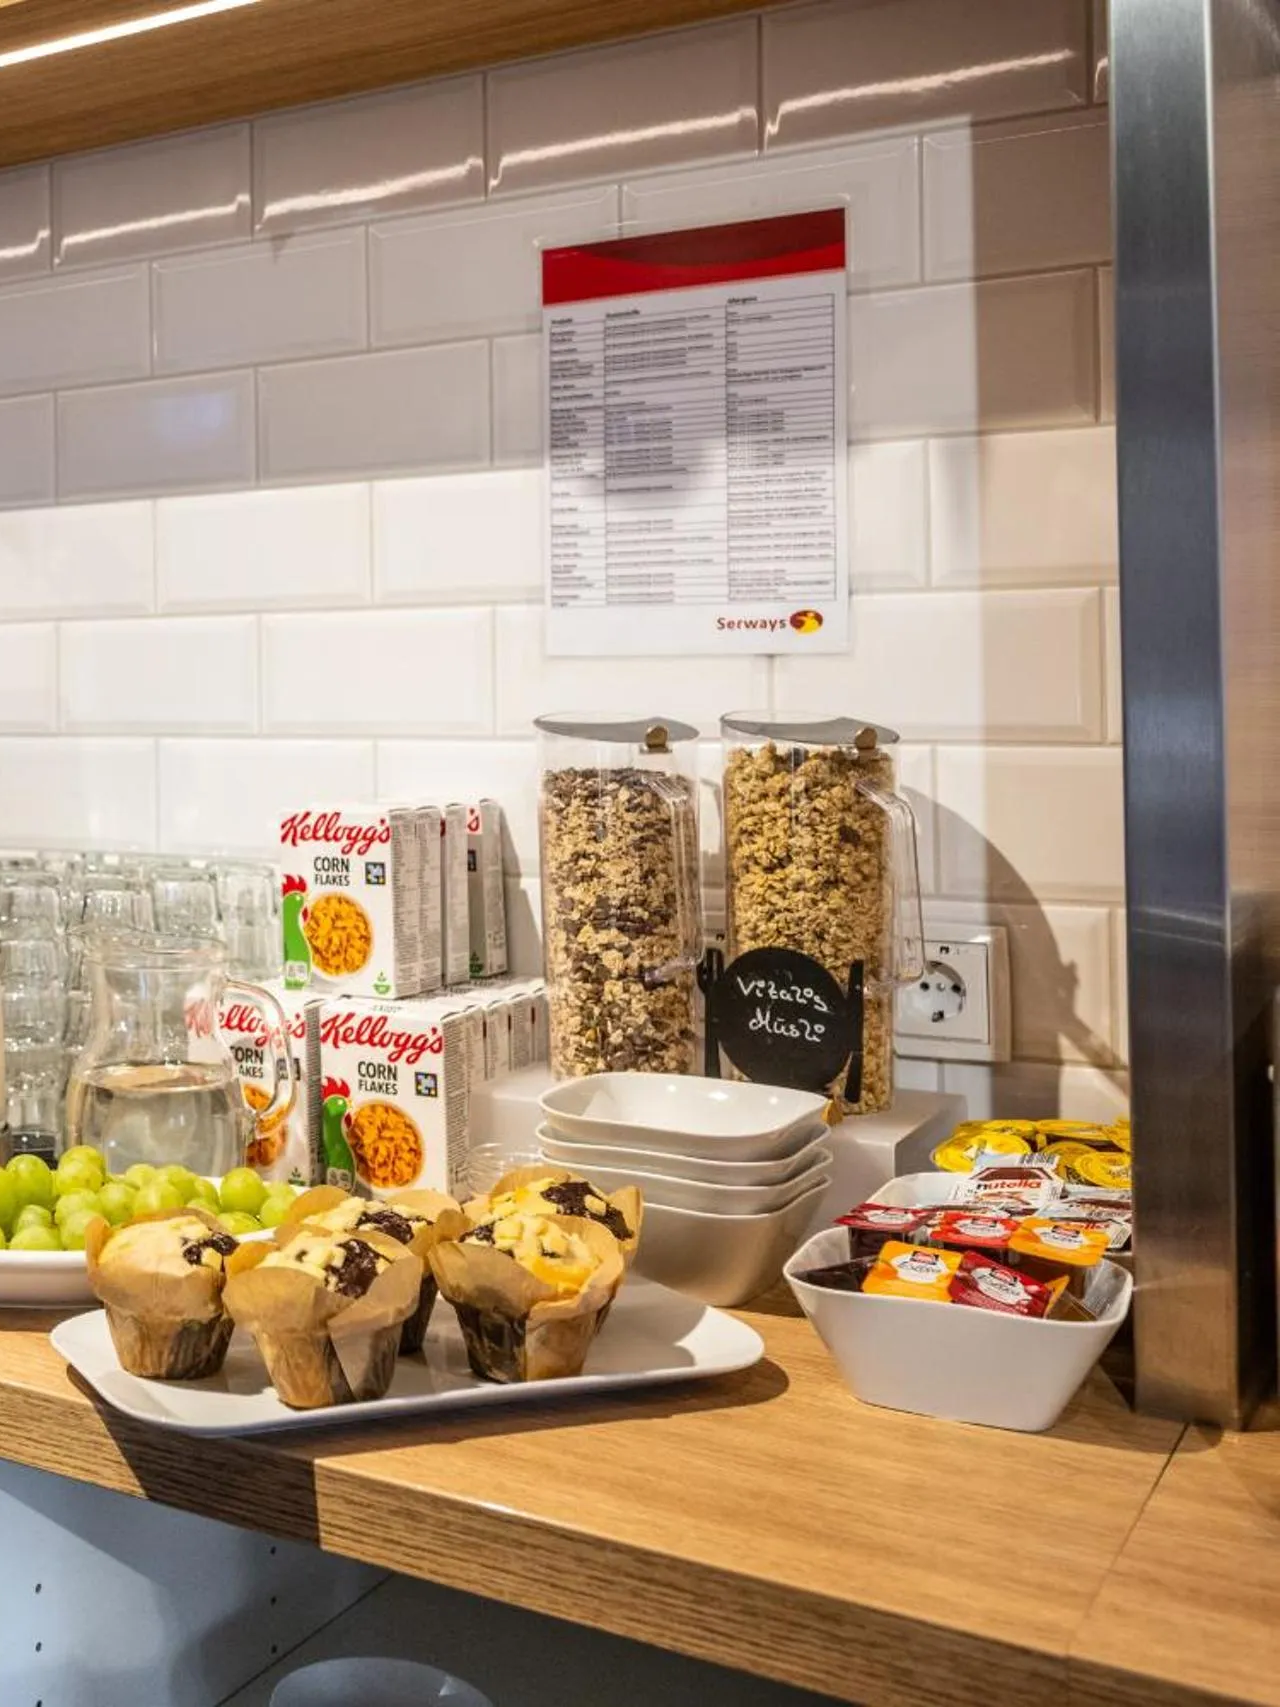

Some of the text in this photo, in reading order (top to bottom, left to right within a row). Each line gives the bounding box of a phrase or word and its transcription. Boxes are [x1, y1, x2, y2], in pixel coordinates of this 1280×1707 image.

[716, 618, 786, 632] Serways
[280, 811, 390, 855] Kellogg's
[314, 857, 350, 872] CORN
[315, 874, 350, 886] FLAKES
[320, 1012, 444, 1064] Kellogg's
[238, 1065, 264, 1078] AKES
[358, 1061, 398, 1080] CORN
[359, 1080, 398, 1095] FLAKES
[976, 1180, 1042, 1190] nutella
